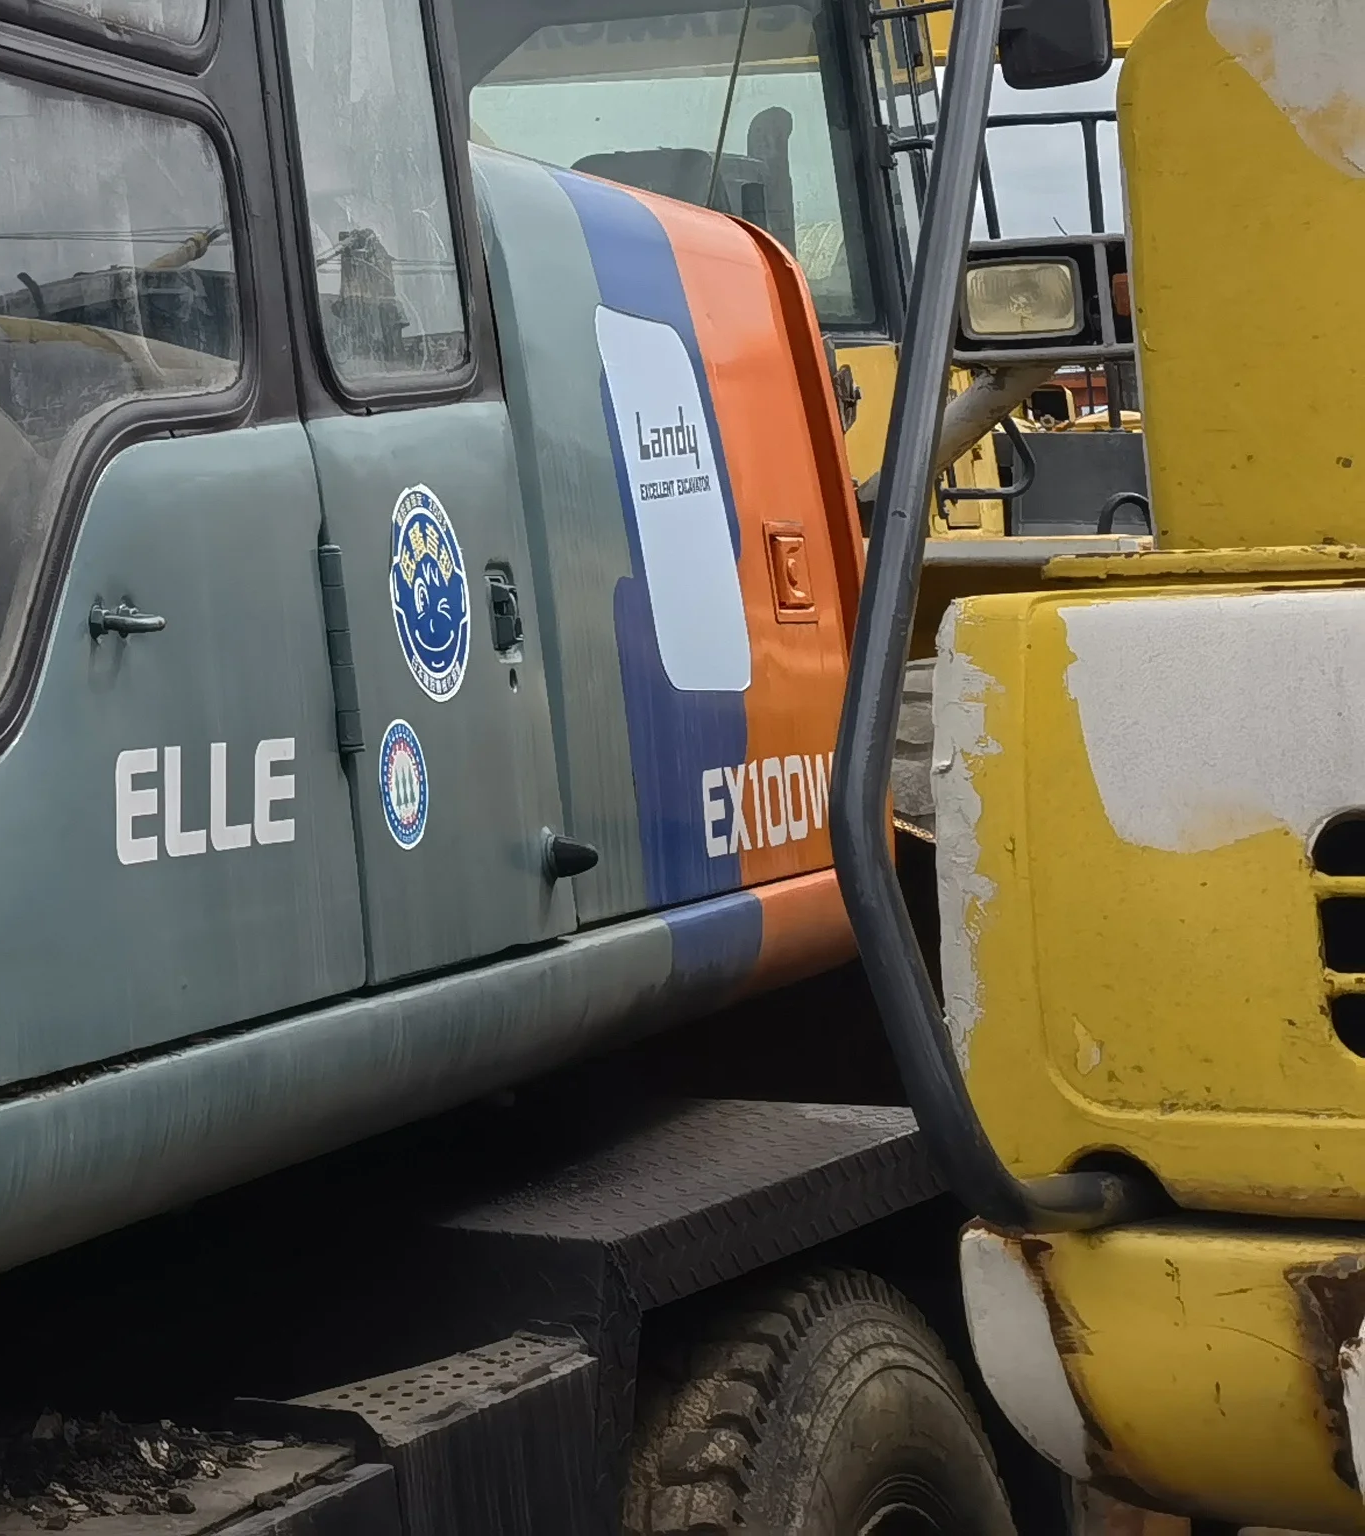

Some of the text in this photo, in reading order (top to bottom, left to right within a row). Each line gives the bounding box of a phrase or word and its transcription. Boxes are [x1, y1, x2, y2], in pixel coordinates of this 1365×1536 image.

[635, 406, 700, 470] Landy
[640, 475, 711, 501] EXCELLENT EXCAVATOR
[115, 737, 295, 865] ELLE
[702, 751, 834, 859] EX100W
